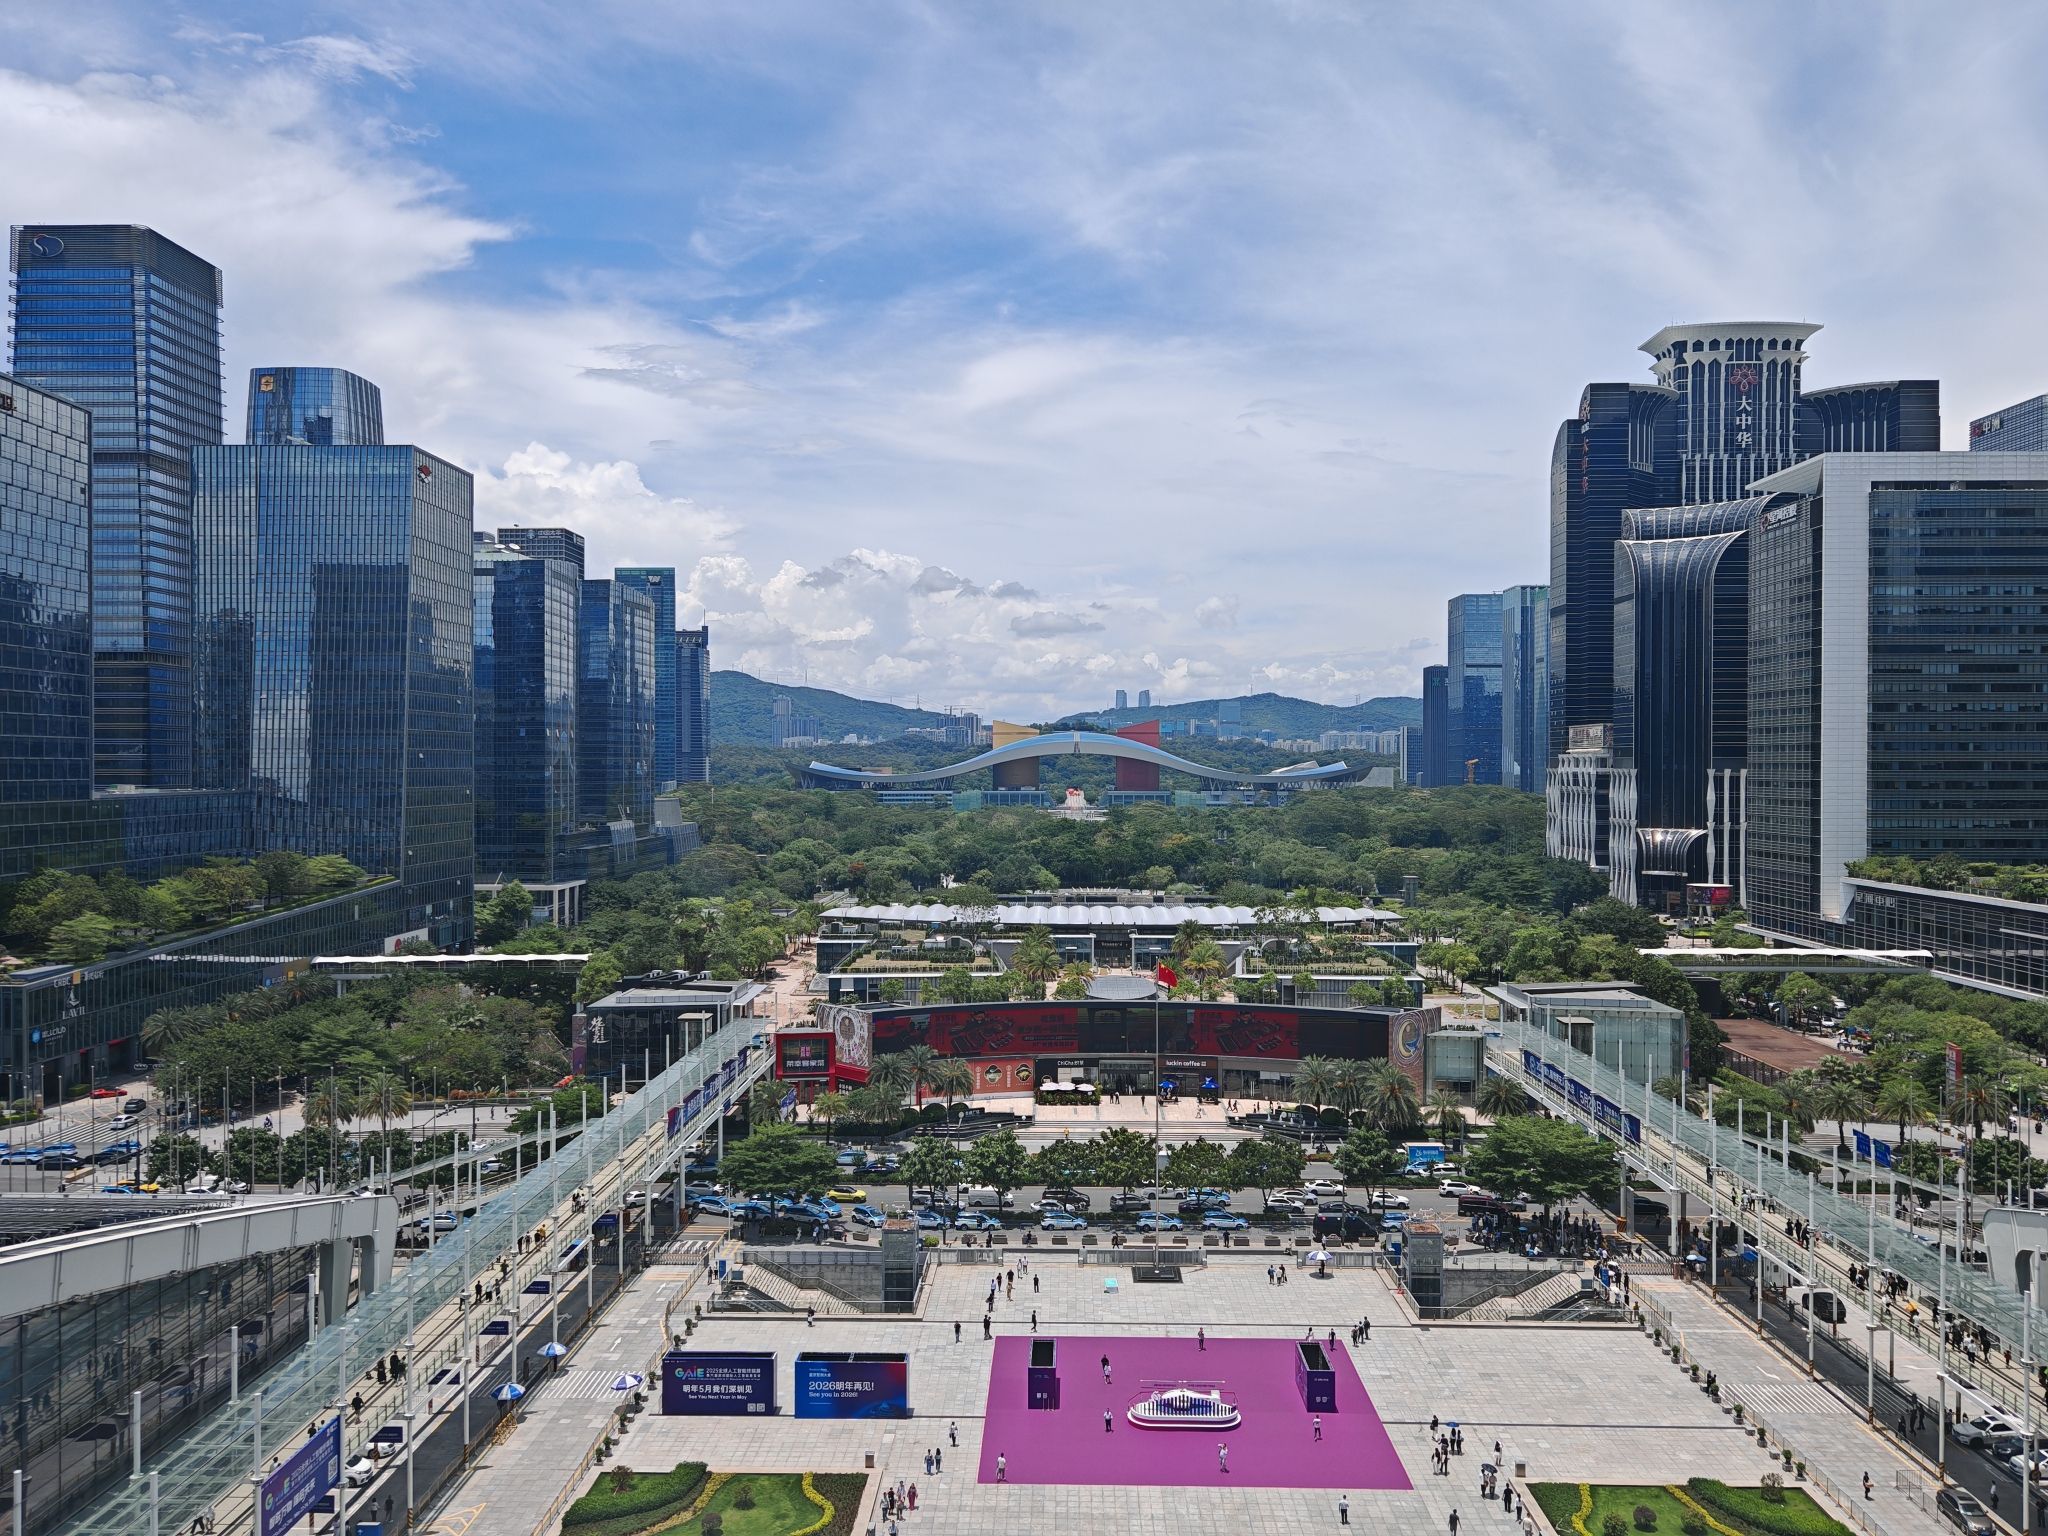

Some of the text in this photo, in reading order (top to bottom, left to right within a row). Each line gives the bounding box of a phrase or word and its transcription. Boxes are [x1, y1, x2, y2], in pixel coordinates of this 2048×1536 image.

[1735, 395, 1752, 448] 大中华
[682, 1385, 753, 1393] 明年5月我们深圳见
[809, 1381, 874, 1391] 2026明年再见!
